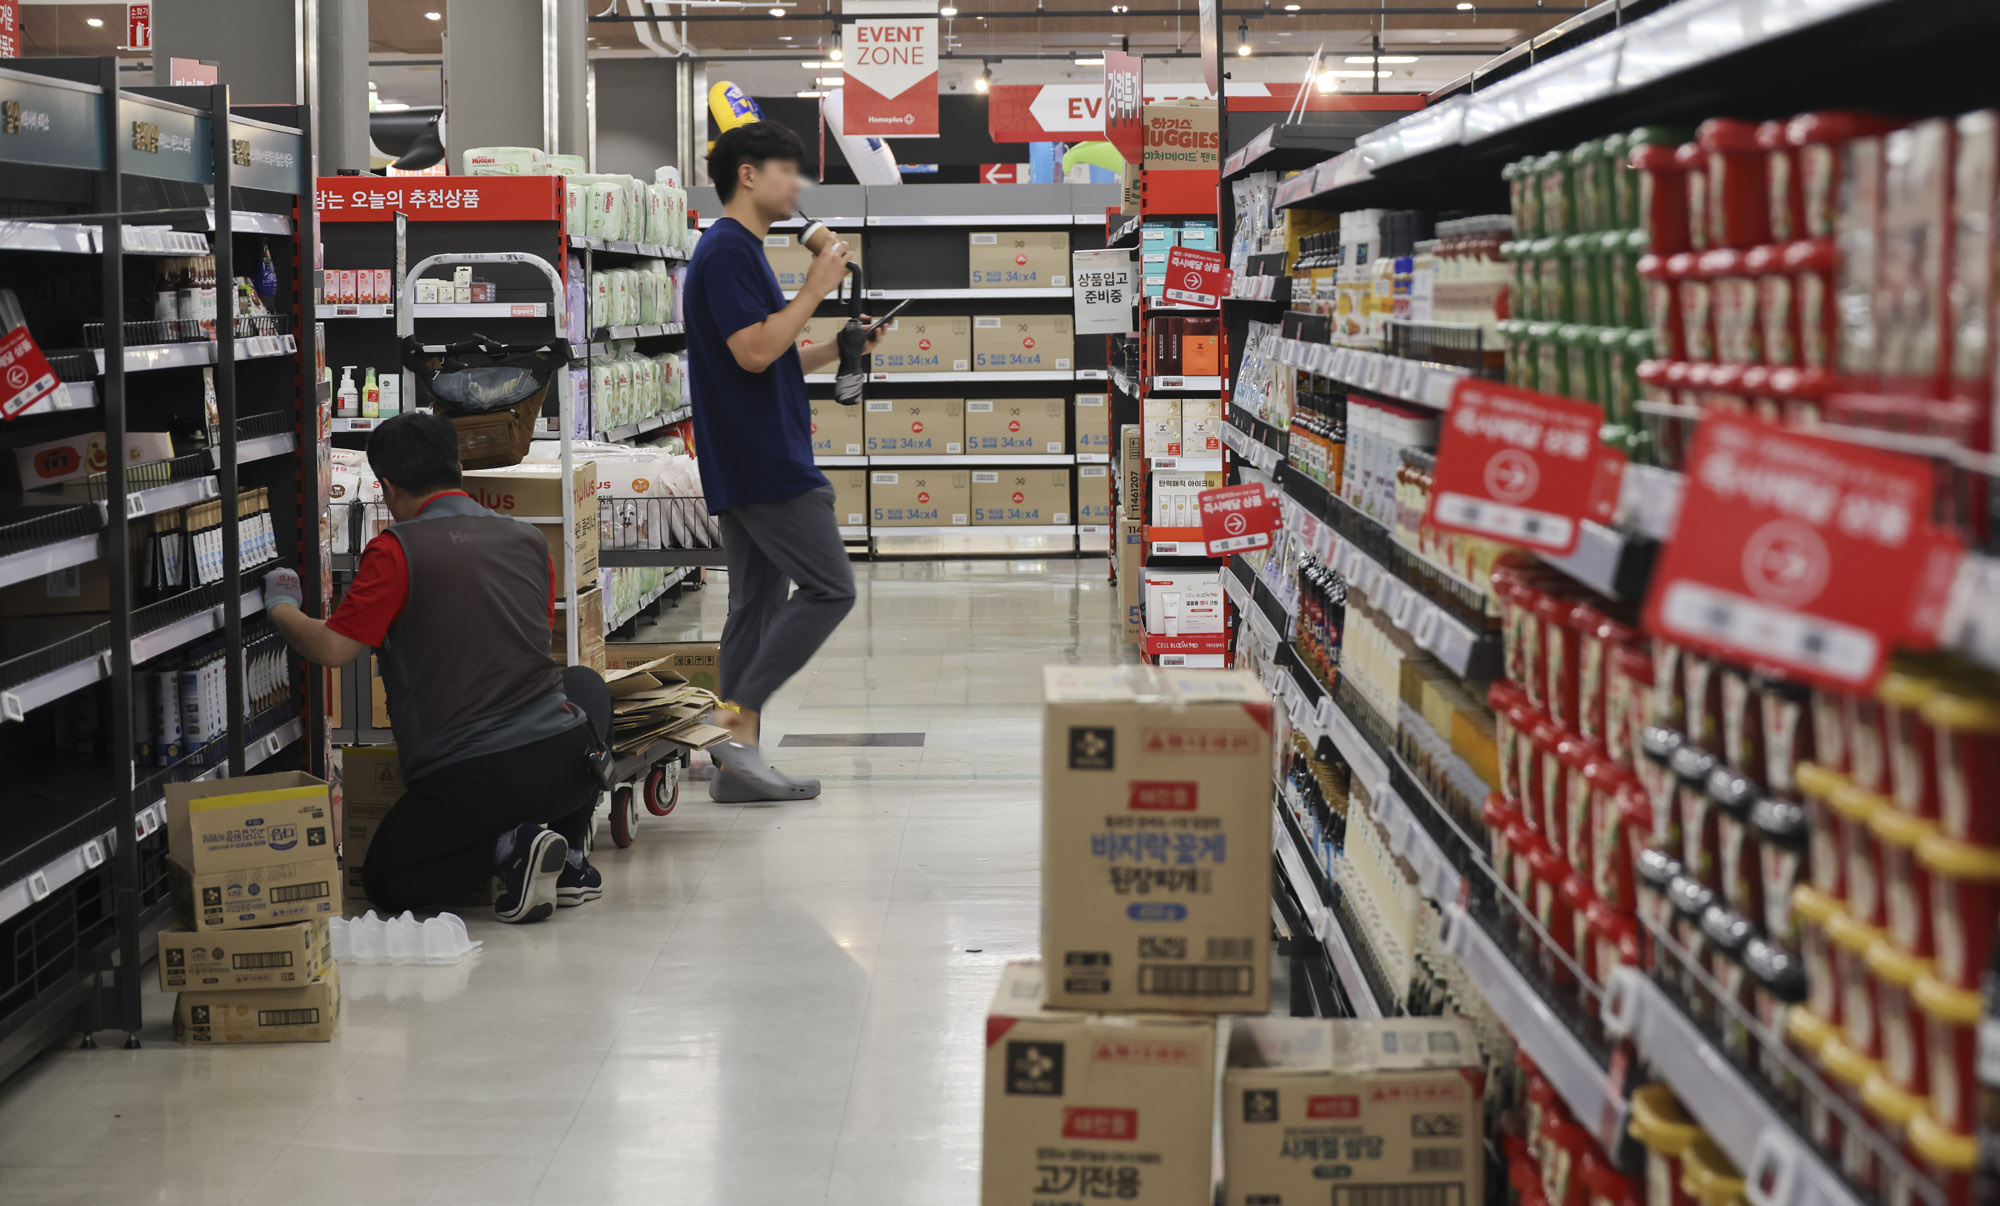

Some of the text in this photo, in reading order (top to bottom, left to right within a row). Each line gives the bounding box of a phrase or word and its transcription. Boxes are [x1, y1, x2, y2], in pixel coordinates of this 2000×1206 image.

[857, 26, 924, 43] EVENT
[857, 46, 924, 65] ZONE
[1108, 70, 1140, 120] 강력특가
[868, 116, 903, 124] Homeplus
[1151, 117, 1192, 129] 하기스
[351, 189, 403, 209] 오늘의
[409, 189, 480, 209] 추천상품
[1171, 256, 1203, 270] 즉시배달
[1204, 262, 1220, 273] 상품
[973, 270, 983, 283] 5
[1078, 272, 1128, 287] 상품입고
[1085, 289, 1123, 304] 준비중
[875, 354, 885, 367] 5
[977, 353, 986, 366] 5
[868, 438, 878, 450] 5
[968, 437, 978, 449] 5
[874, 508, 884, 521] 5
[975, 508, 985, 521] 5
[1109, 867, 1198, 895] 된장찌개
[1034, 1165, 1141, 1200] 고기전용
